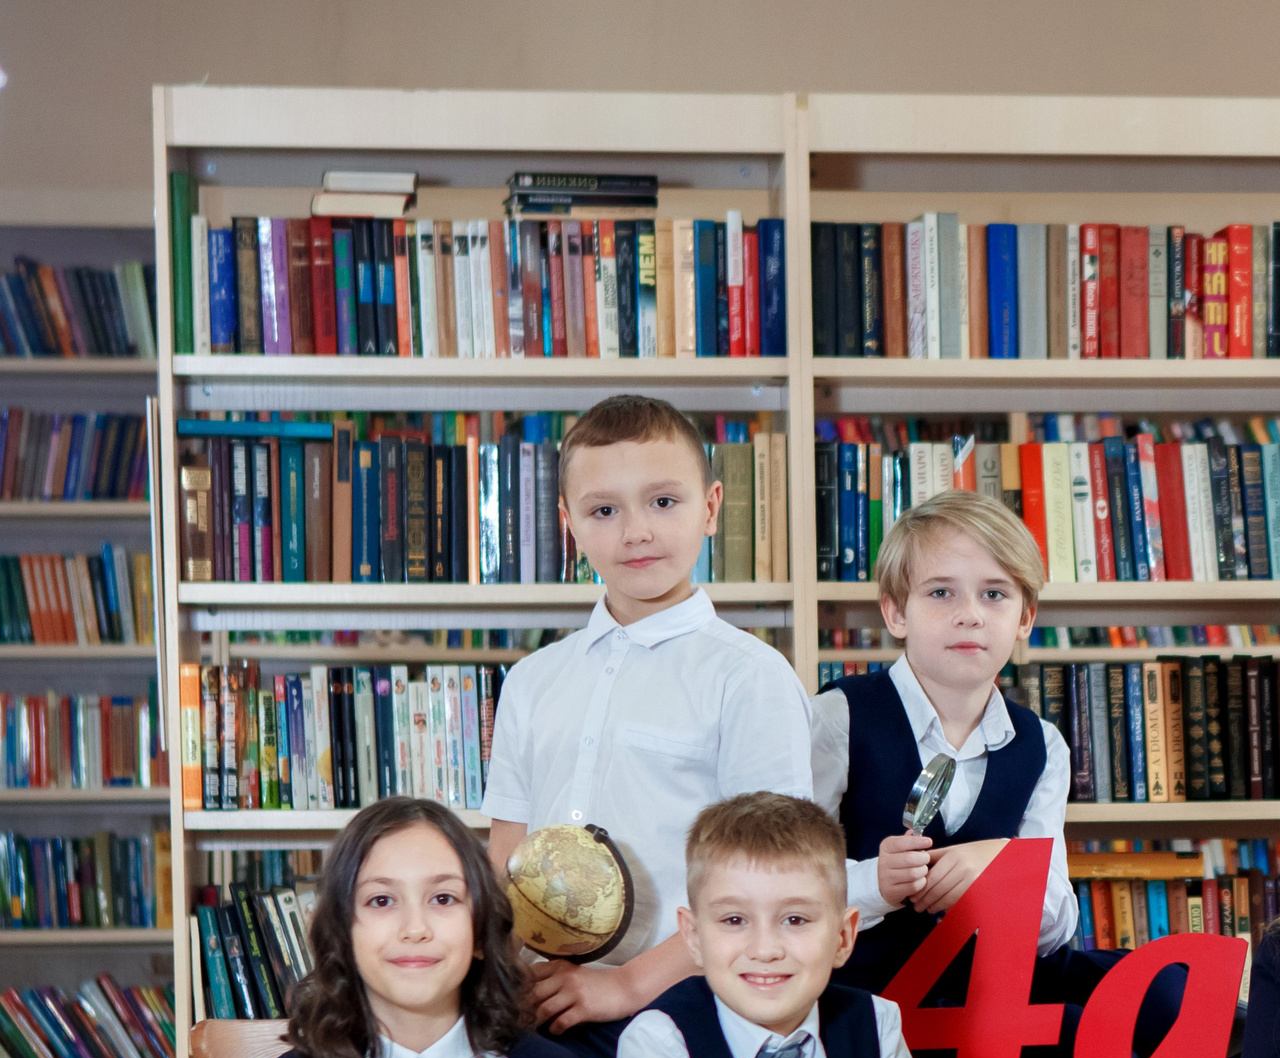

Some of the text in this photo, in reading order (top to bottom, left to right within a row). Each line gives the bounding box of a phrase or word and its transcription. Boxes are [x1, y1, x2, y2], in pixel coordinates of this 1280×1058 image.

[638, 234, 656, 287] ЛЕМ
[1228, 447, 1238, 476] Дрюон
[1132, 484, 1142, 522] РАМЗЕС
[1220, 479, 1228, 514] КОРОНА
[1191, 904, 1202, 932] АМЮ
[1221, 888, 1232, 923] КАМЮ
